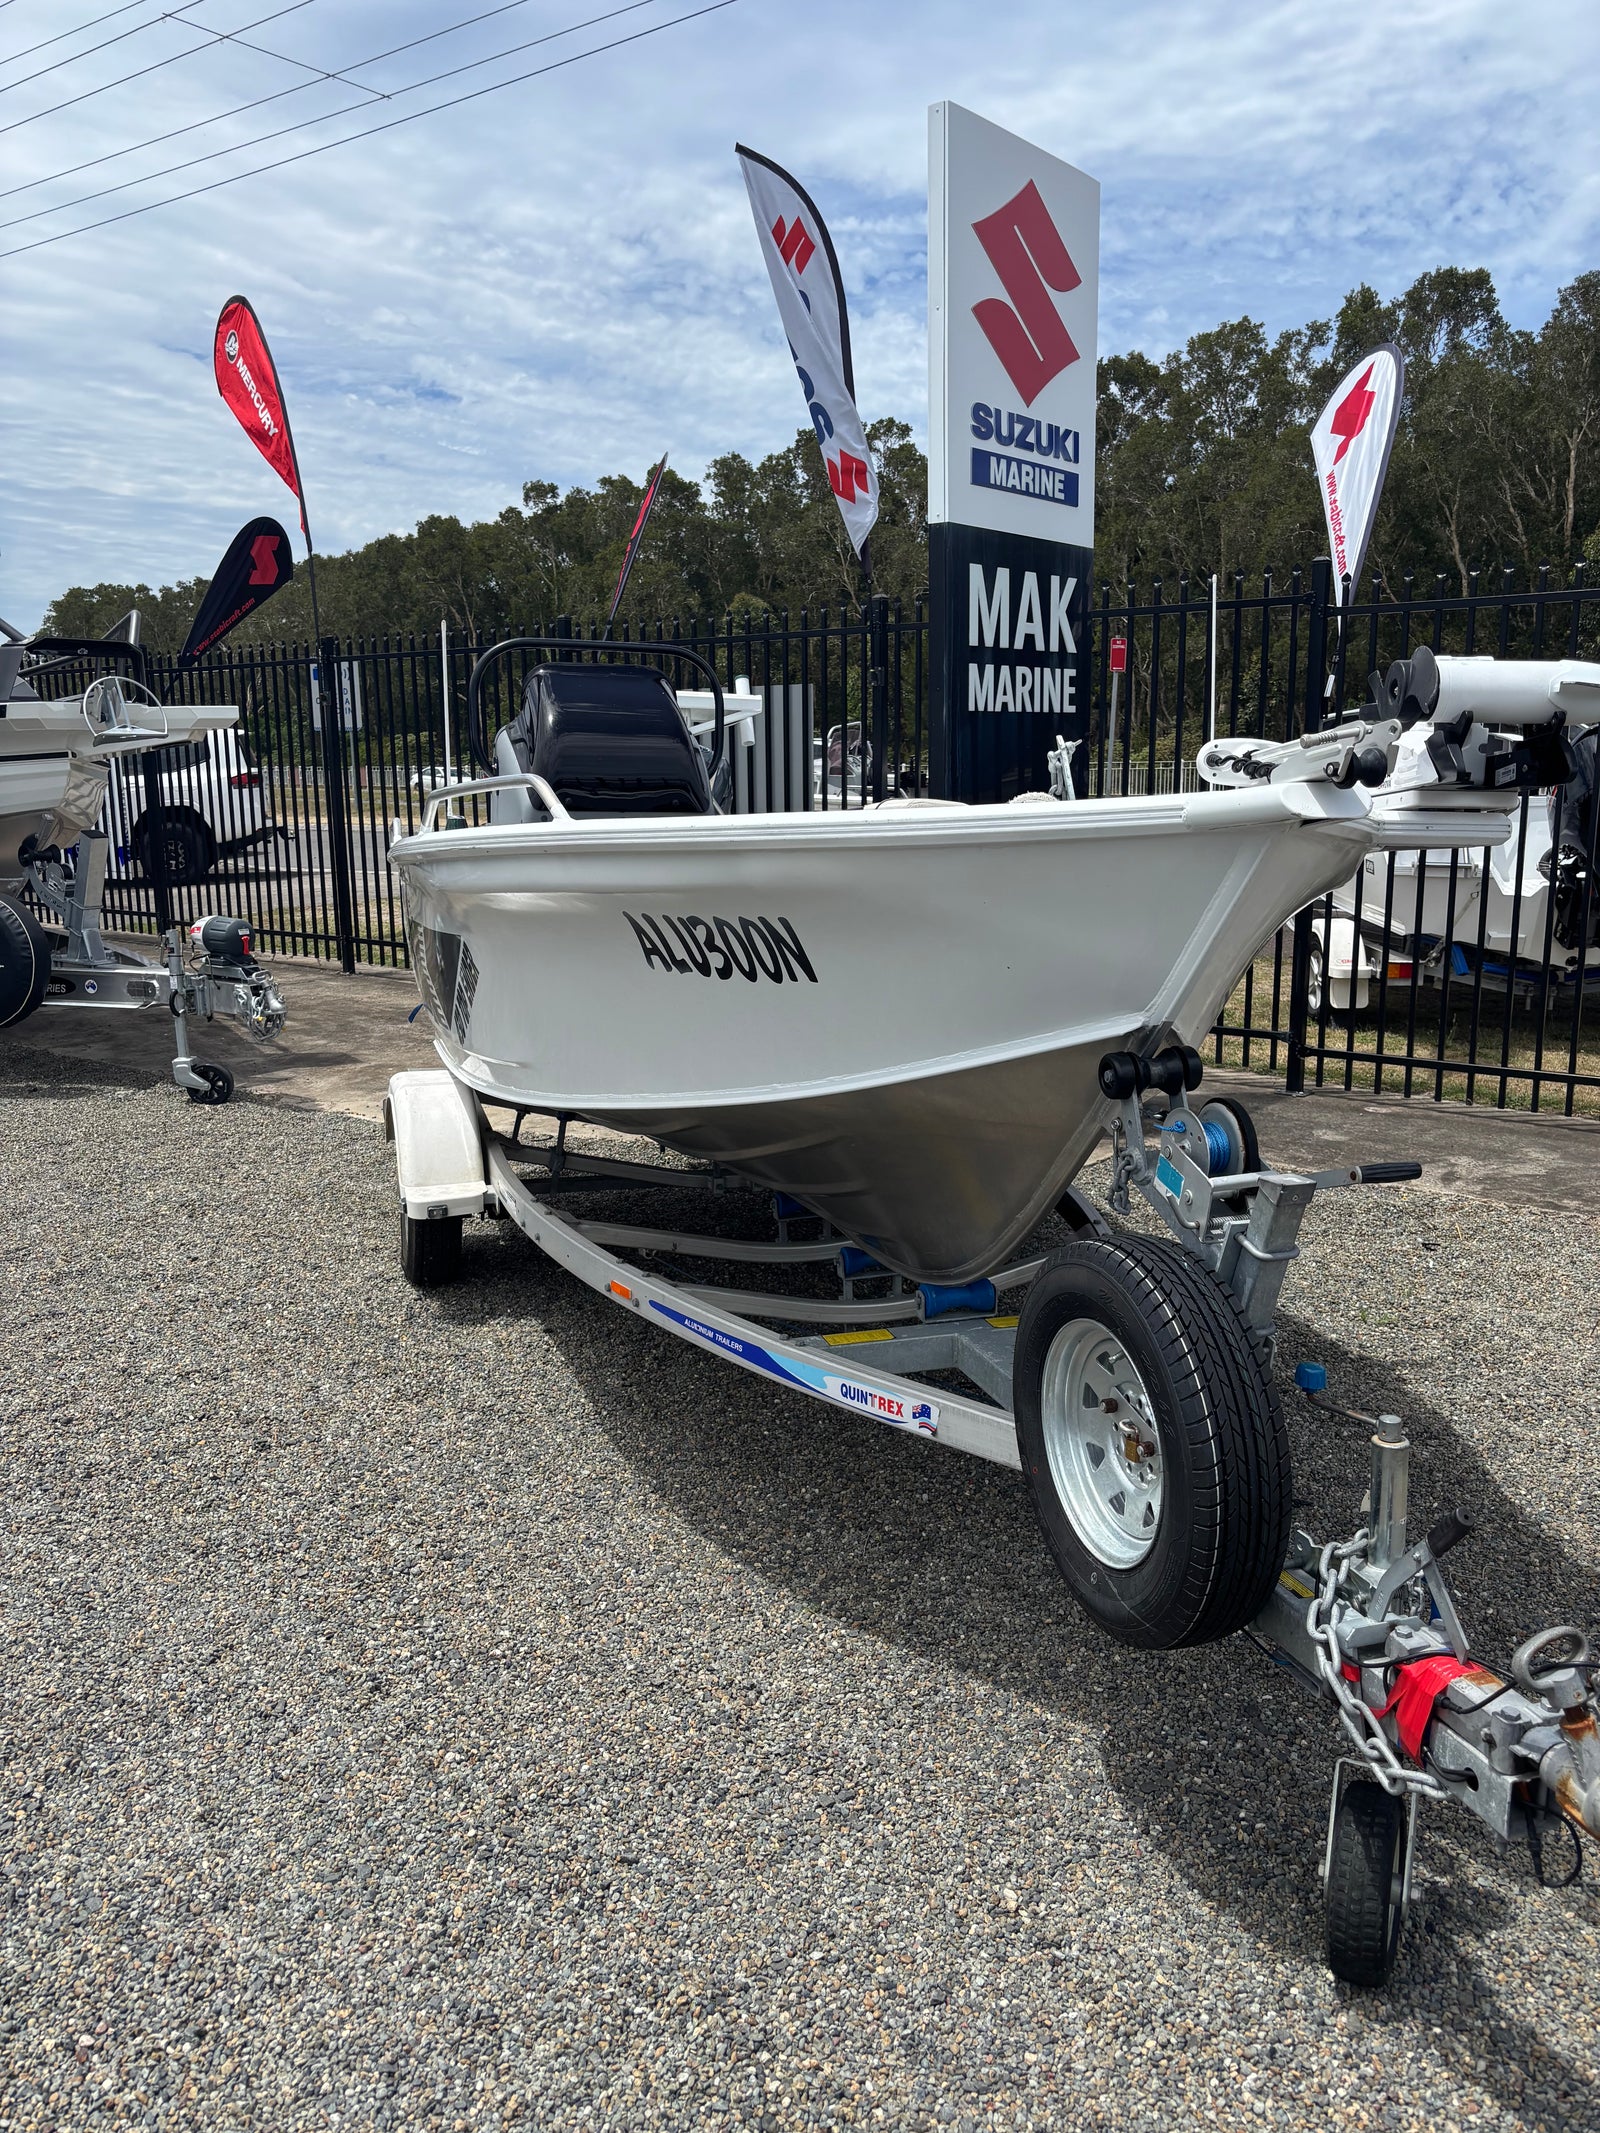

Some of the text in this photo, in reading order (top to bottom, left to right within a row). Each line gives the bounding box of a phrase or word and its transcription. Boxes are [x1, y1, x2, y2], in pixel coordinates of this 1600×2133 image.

[236, 355, 278, 437] MERCURY
[971, 402, 1079, 464] SUZUKI
[990, 456, 1064, 500] MARINE
[969, 563, 1078, 653] MAK
[968, 663, 1077, 713] MARINE
[622, 910, 818, 984] ALU300N
[715, 1333, 743, 1352] TRAILERS
[840, 1383, 904, 1417] QUINTREX
